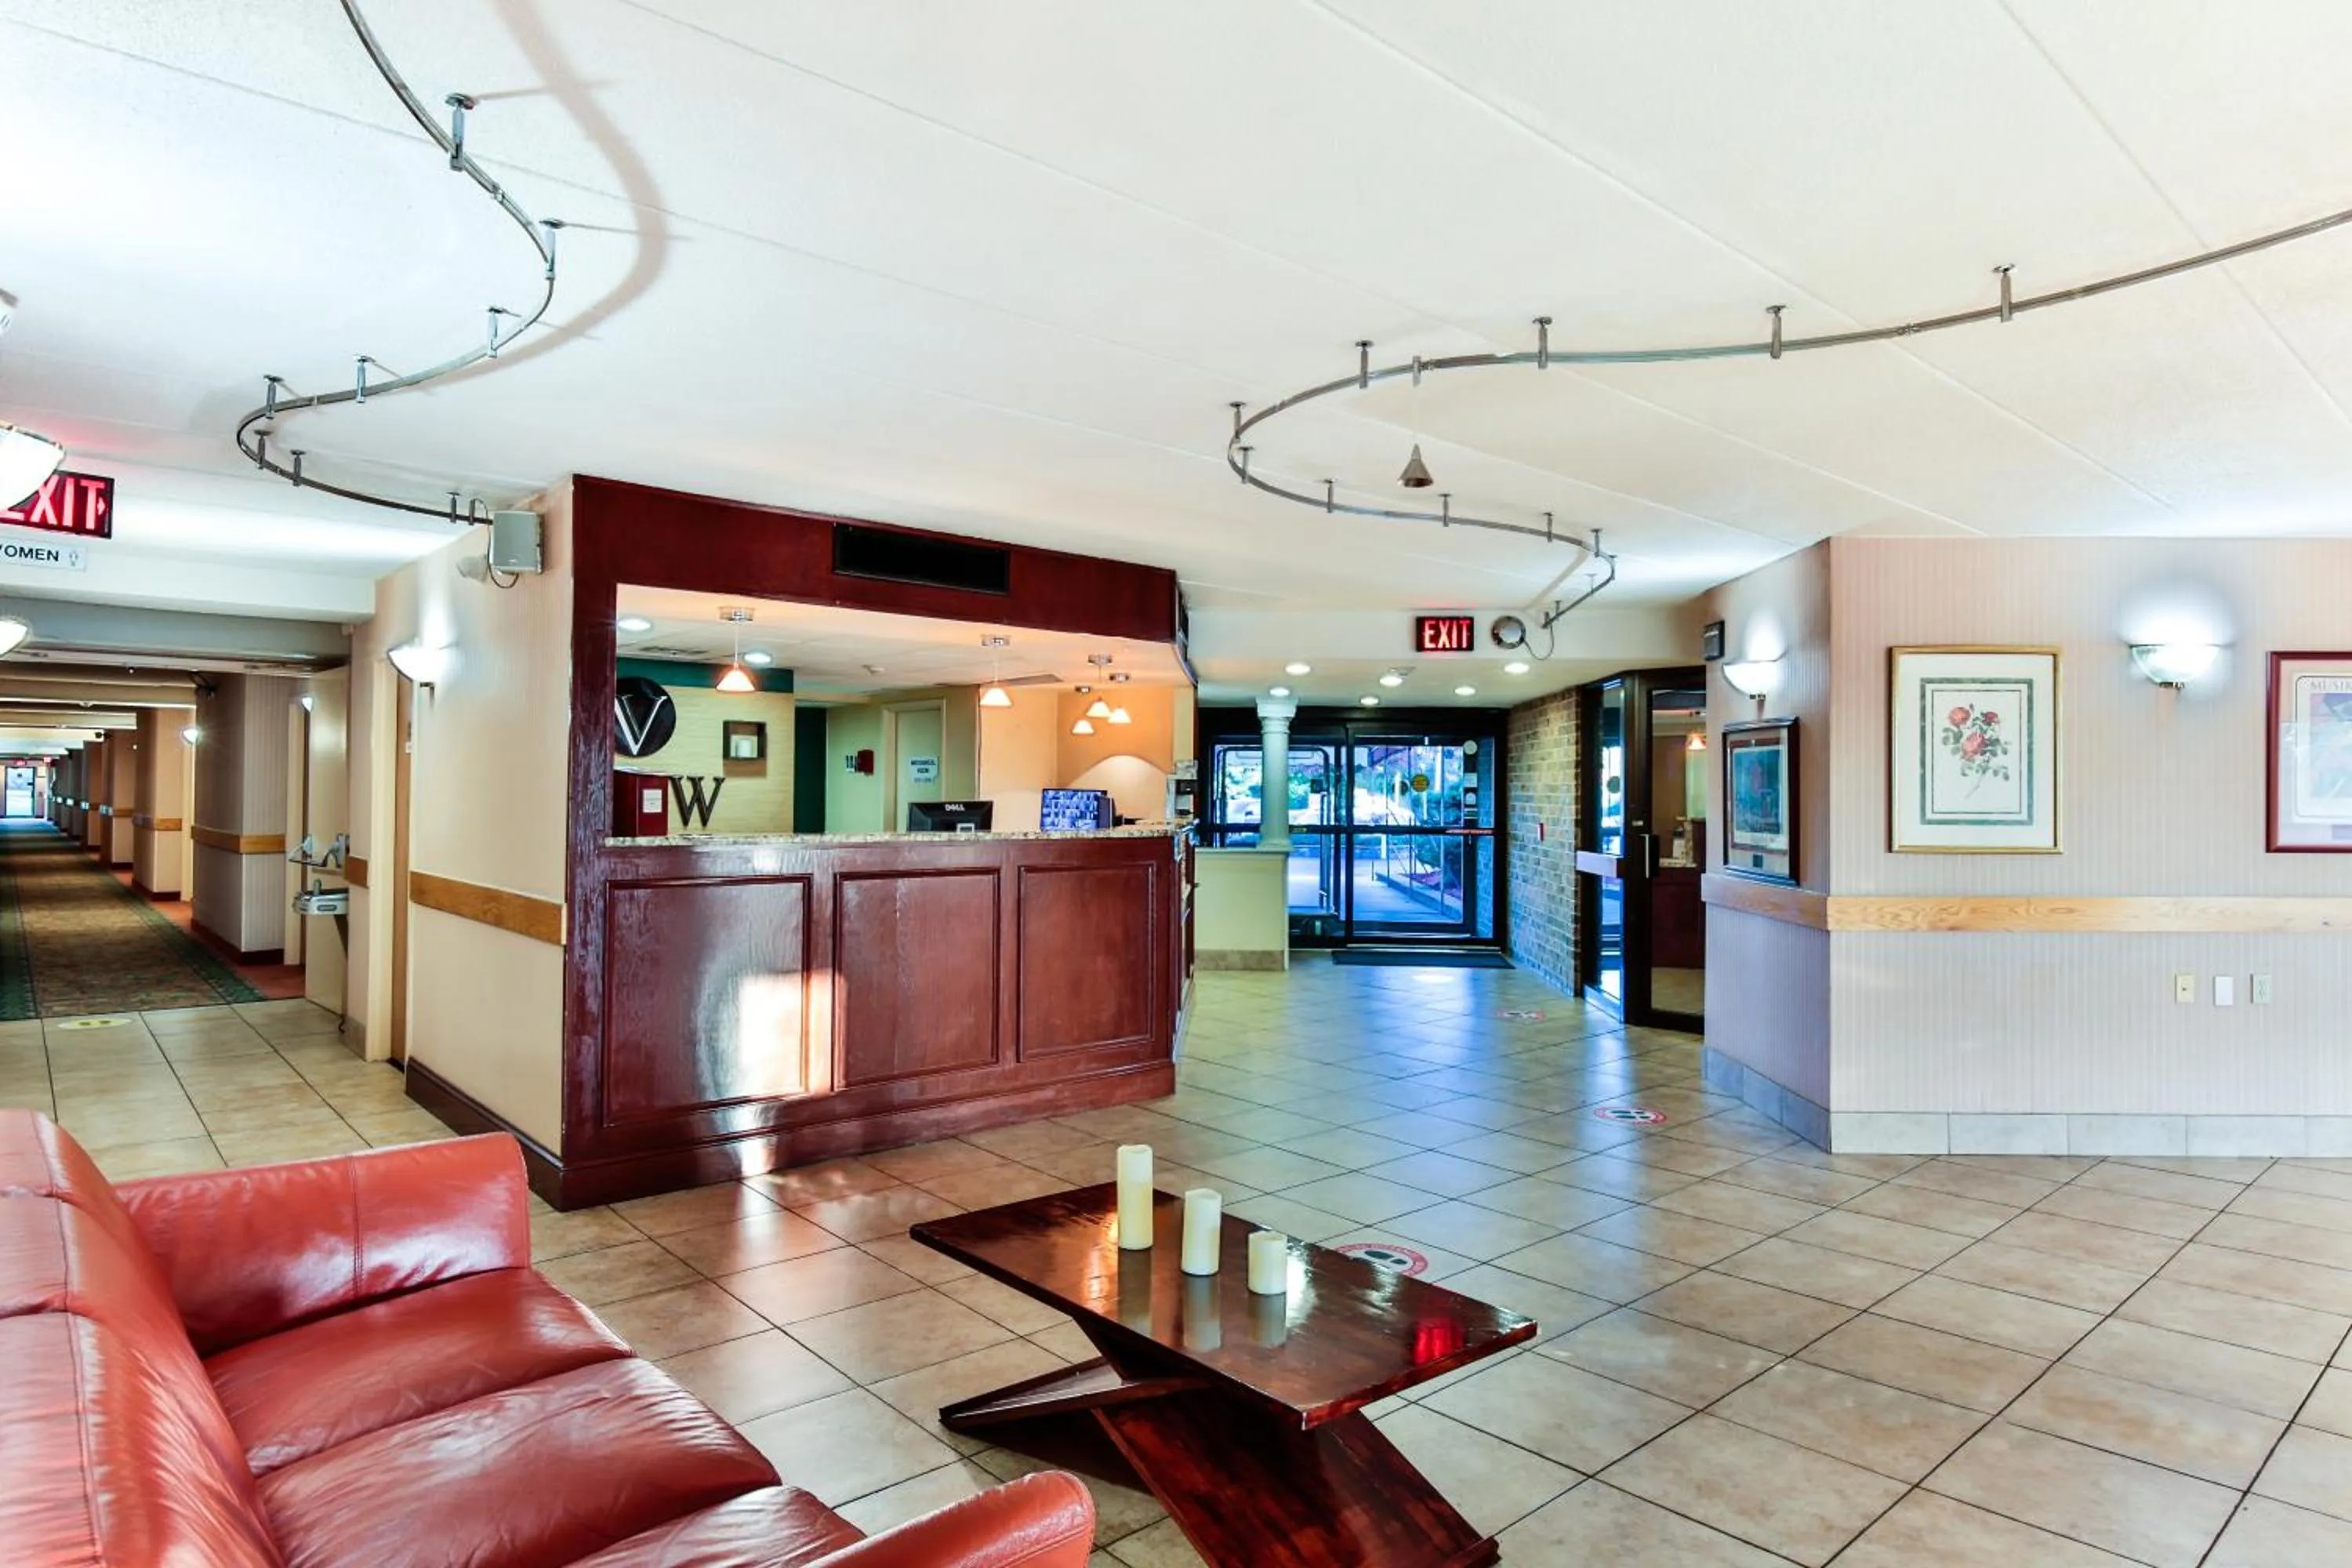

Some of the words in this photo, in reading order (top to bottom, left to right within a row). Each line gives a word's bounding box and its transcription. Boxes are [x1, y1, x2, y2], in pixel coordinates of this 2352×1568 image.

[0, 474, 105, 530] XIT
[0, 545, 60, 562] OMEN
[1424, 619, 1472, 649] EXIT
[615, 695, 669, 756] V
[669, 775, 726, 828] W
[945, 804, 965, 812] DELL
